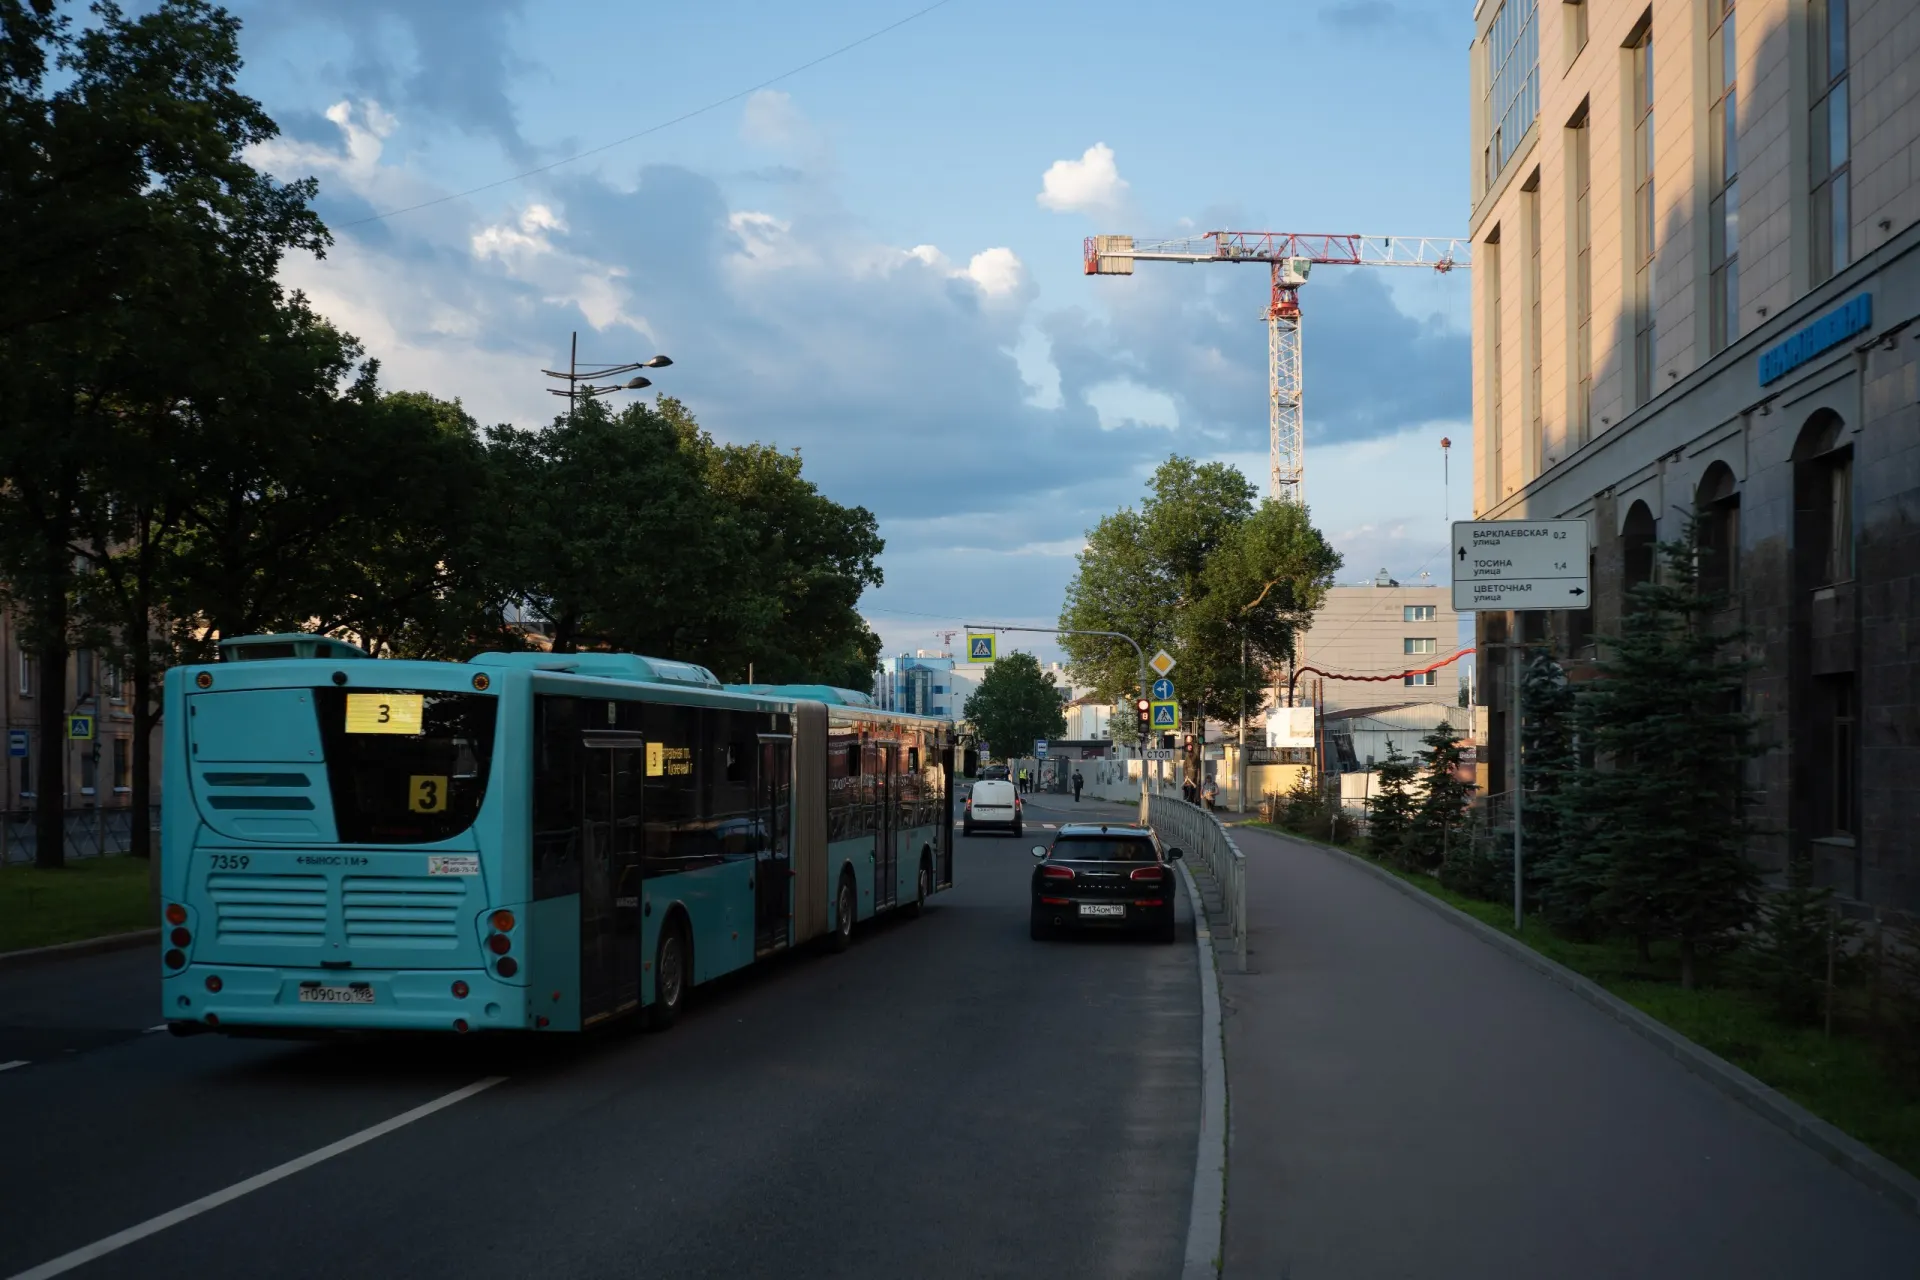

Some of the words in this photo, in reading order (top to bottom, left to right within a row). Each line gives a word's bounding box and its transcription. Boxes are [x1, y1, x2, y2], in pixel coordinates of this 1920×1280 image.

[1473, 529, 1548, 538] БАРКЛАЕВСКАЯ
[1473, 538, 1501, 547] улица
[1474, 559, 1512, 568] ТОСИНА
[1554, 562, 1567, 570] 1,4
[1473, 567, 1501, 576] улица
[1474, 584, 1532, 594] ЦВЕТОЧНАЯ
[1474, 594, 1501, 603] улица
[377, 704, 390, 723] 3
[1147, 750, 1171, 759] СТОП
[419, 780, 437, 809] 3
[210, 855, 250, 869] 7359
[305, 856, 341, 866] ВЫНОС
